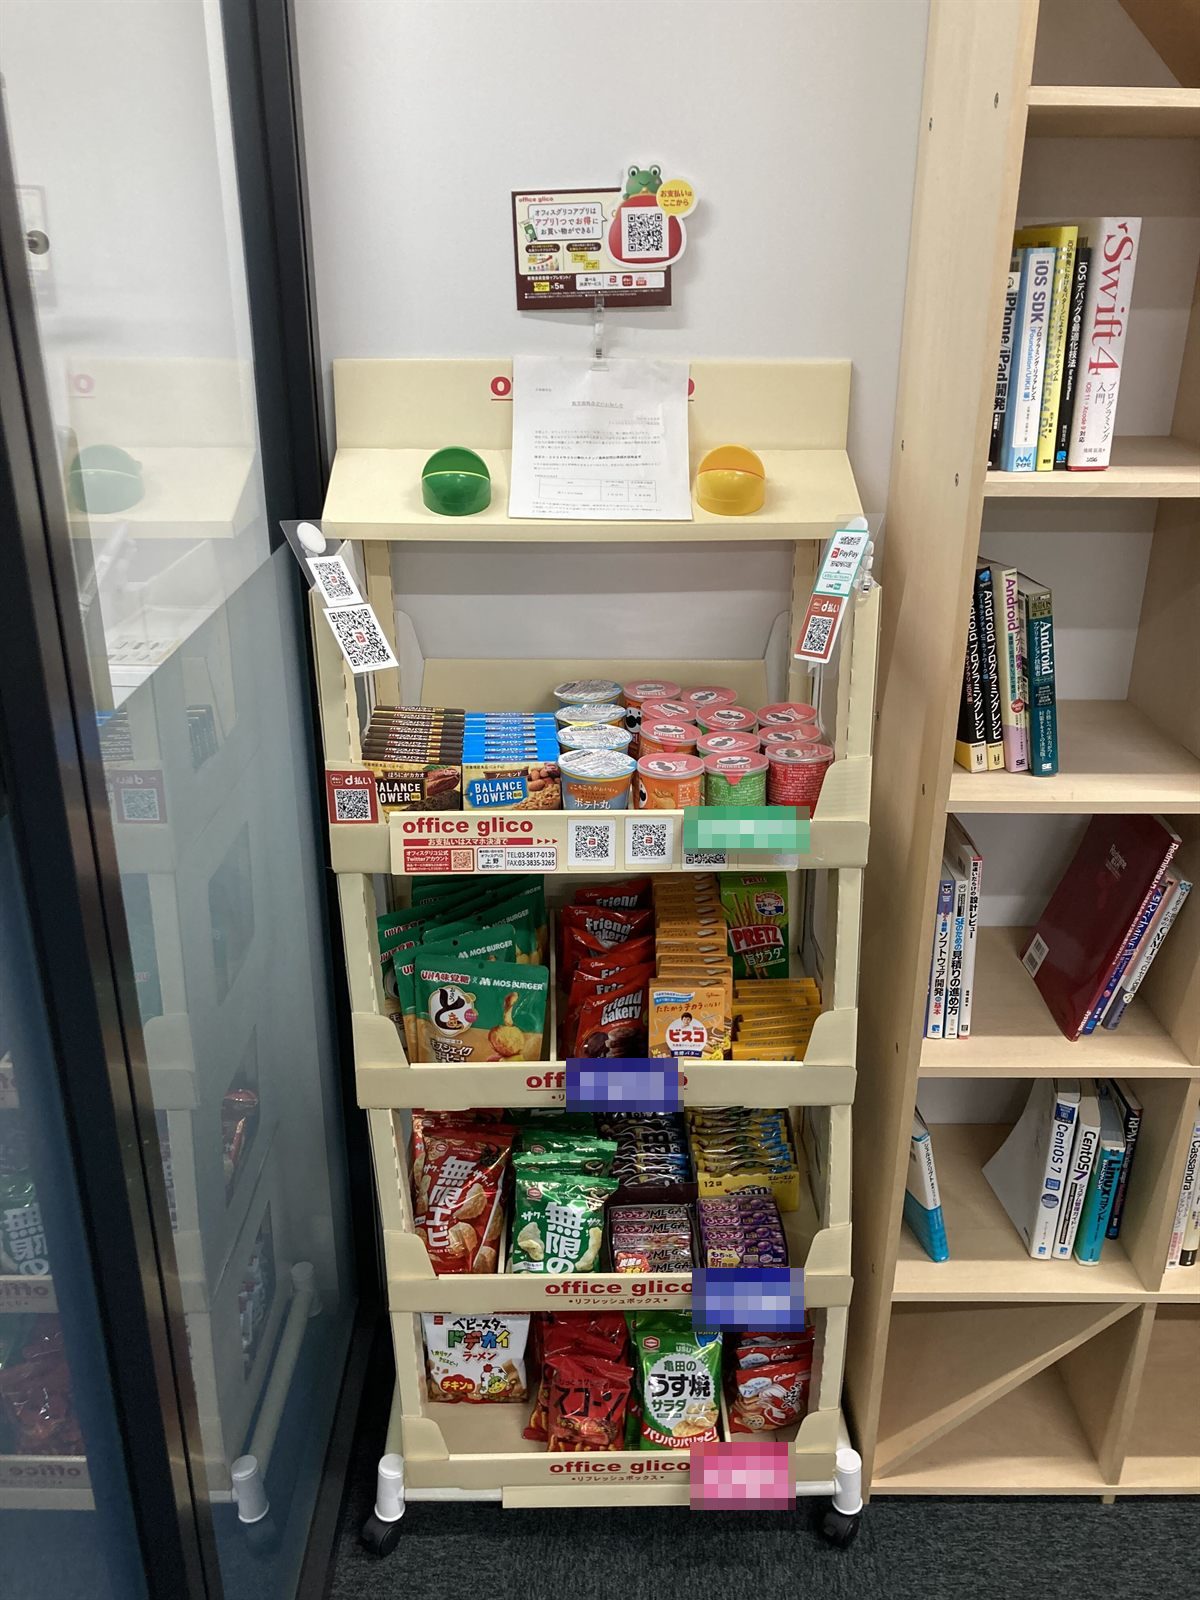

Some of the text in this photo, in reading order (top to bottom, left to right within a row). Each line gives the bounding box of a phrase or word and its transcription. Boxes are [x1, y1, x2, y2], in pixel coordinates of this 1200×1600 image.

[660, 190, 692, 198] お支払いは
[535, 217, 598, 226] アプリ1つでお得に
[1078, 261, 1088, 281] iOS
[1031, 260, 1049, 323] iOS SDK
[1088, 233, 1134, 376] Swift 4
[1094, 382, 1105, 404] 入門
[1107, 382, 1117, 443] プログラミング
[839, 550, 859, 558] PayPay
[1005, 578, 1020, 631] Android
[1040, 621, 1053, 674] Android
[984, 590, 1002, 739] Android プログラミングレシピ
[345, 777, 372, 785] d払い
[474, 782, 523, 793] BALANCE
[476, 792, 512, 804] POWER
[574, 798, 611, 810] ポテト丸
[402, 818, 534, 839] office glico
[596, 895, 638, 908] Friend
[586, 918, 632, 936] Friend
[731, 927, 780, 950] PRETZ
[470, 940, 512, 957] MOS BURGER
[746, 947, 783, 965] 旨サラダ
[421, 970, 470, 984] UHA味覚糖
[492, 979, 543, 990] MOS BURGER
[602, 989, 643, 1012] Friend
[601, 1007, 642, 1027] Bakery
[669, 1029, 704, 1043] ビスコ
[1125, 1116, 1140, 1142] RPM
[1049, 1122, 1069, 1174] CentOS 7
[1078, 1130, 1097, 1171] CentOS
[1184, 1140, 1200, 1191] Cassandra
[1101, 1160, 1121, 1197] Linux
[426, 1156, 478, 1247] 無限エビ
[649, 1208, 683, 1218] MEGA
[652, 1223, 687, 1233] MEGA
[545, 1280, 692, 1297] office glico
[574, 1297, 661, 1306] リフレッシュボックス
[452, 1319, 507, 1330] ベビースター
[448, 1330, 510, 1349] ドデカイ
[462, 1351, 497, 1361] ラーメン
[664, 1360, 696, 1371] 亀田の
[650, 1374, 711, 1398] うす焼
[651, 1399, 687, 1412] サラダ
[549, 1459, 690, 1475] office glico
